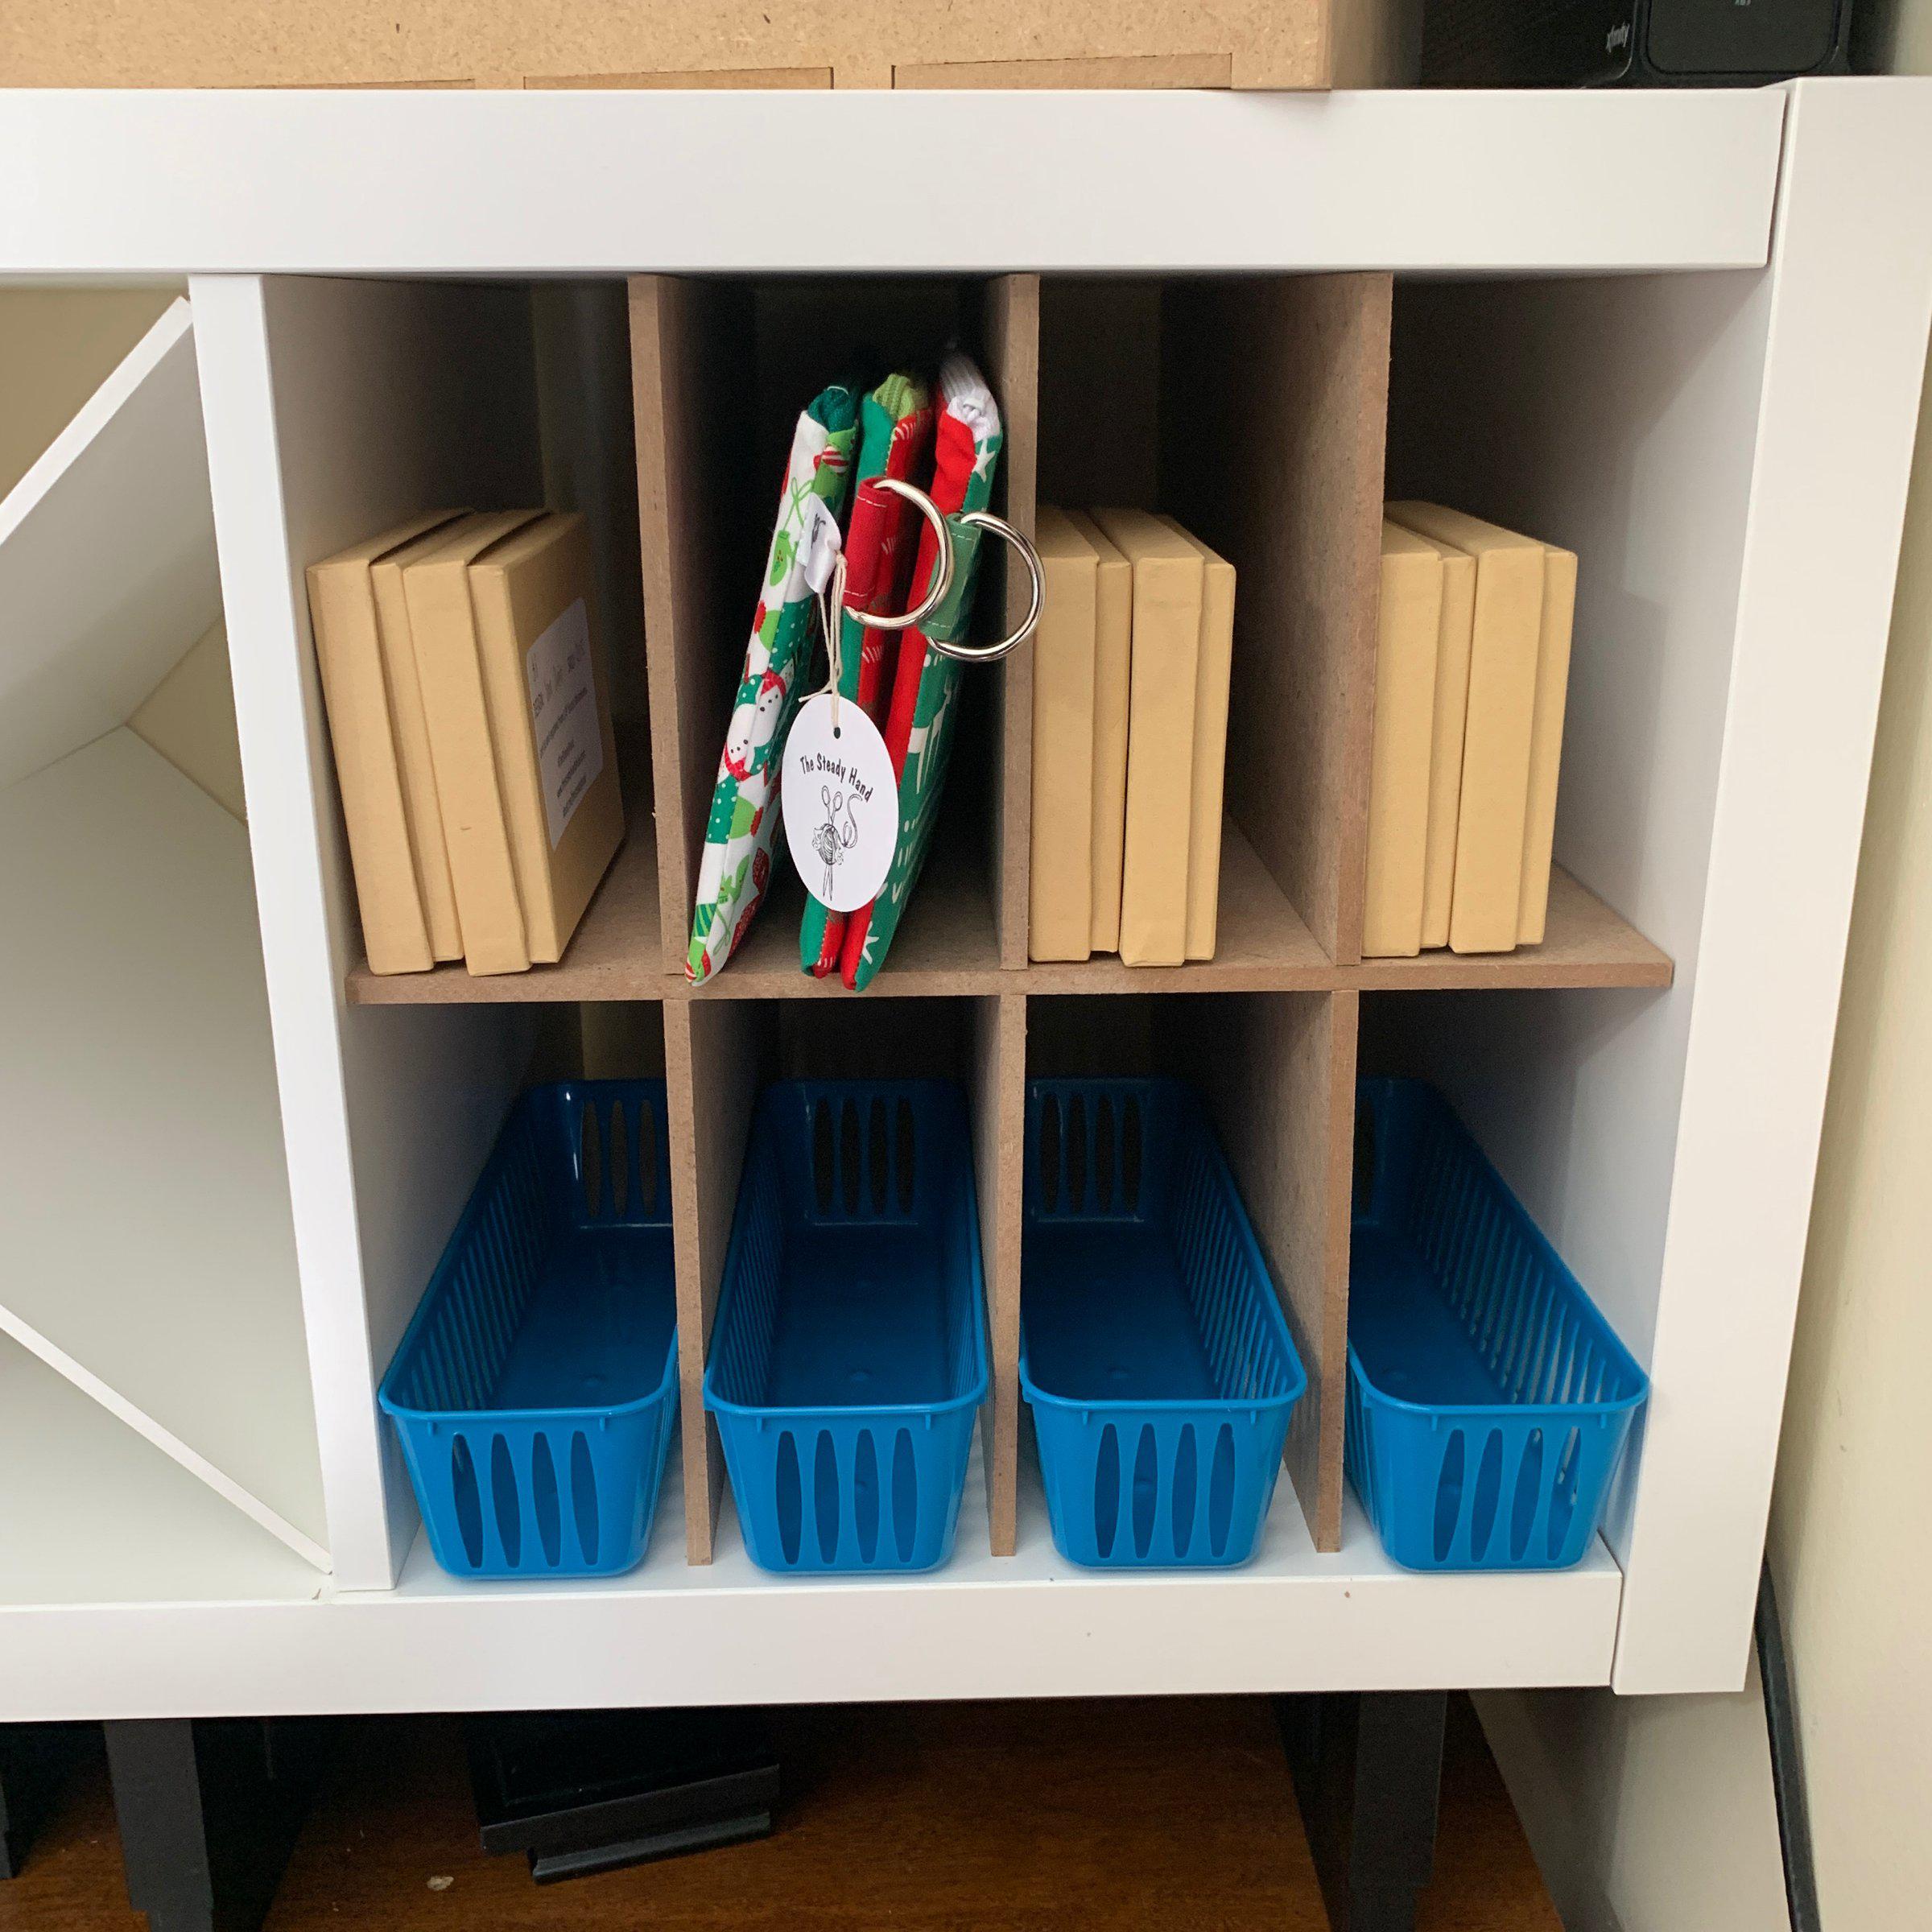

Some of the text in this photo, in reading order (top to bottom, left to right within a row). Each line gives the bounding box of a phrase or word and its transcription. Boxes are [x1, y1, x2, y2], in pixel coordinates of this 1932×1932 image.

[799, 752, 873, 803] The Steady Hand
